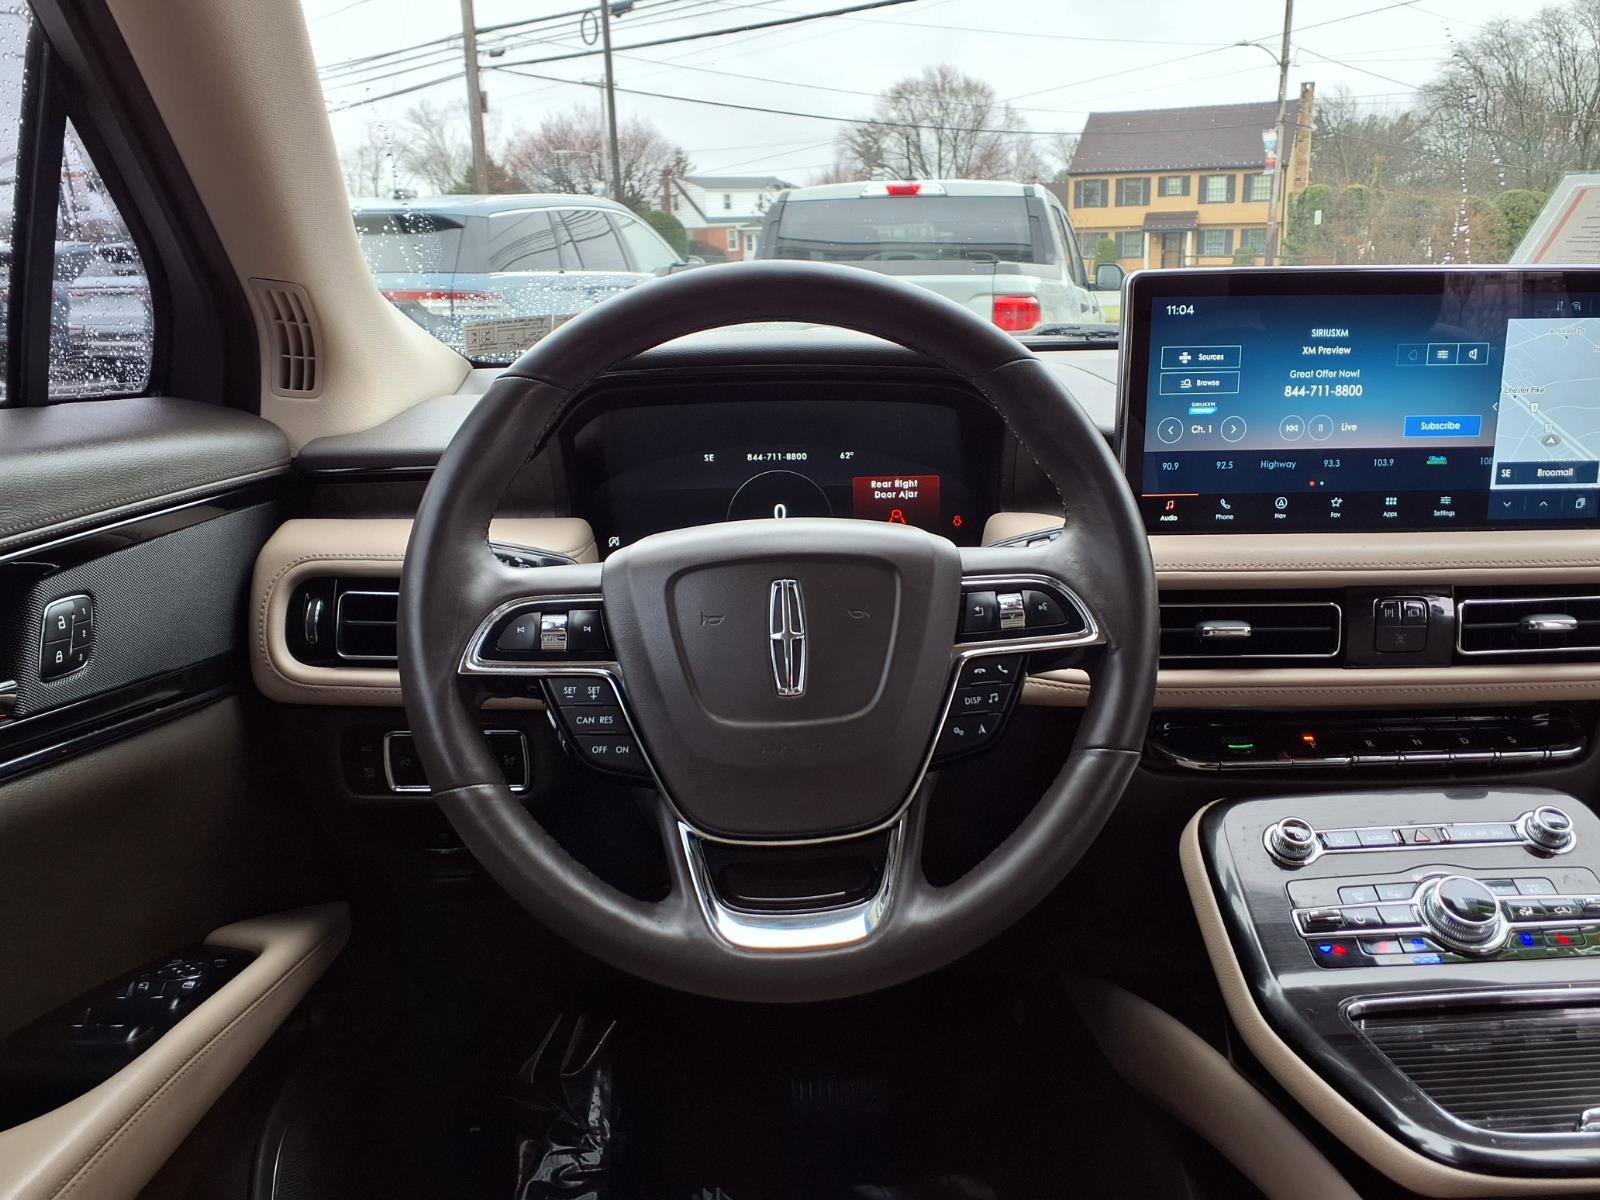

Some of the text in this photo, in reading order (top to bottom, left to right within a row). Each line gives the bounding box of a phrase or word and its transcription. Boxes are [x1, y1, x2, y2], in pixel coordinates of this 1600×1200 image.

[1166, 304, 1195, 316] 11:04
[1311, 328, 1349, 338] SIRIUSXM
[1302, 345, 1351, 355] XM Preview
[1198, 353, 1224, 361] Sources
[1289, 368, 1360, 379] Great Offer Now!
[1196, 378, 1220, 387] Browse
[1284, 384, 1363, 397] 844-711-8800
[1191, 424, 1212, 434] Ch. 1
[1341, 422, 1357, 432] Live
[1420, 421, 1461, 431] Subscribe
[704, 453, 715, 462] SE
[747, 452, 808, 462] 844-711-8800
[1162, 461, 1180, 472] 90.9
[1216, 460, 1234, 471] 92.5
[1260, 459, 1297, 470] Highway
[1323, 459, 1341, 469] 93.3
[1373, 458, 1395, 467] 103.9
[1501, 468, 1511, 478] SE
[1536, 467, 1574, 477] Broomall
[871, 478, 918, 490] Rear Right
[874, 489, 918, 500] Door Ajar
[773, 503, 787, 519] 0
[1383, 510, 1398, 518] Apps
[1433, 508, 1456, 518] Settings
[1160, 514, 1178, 522] Audio
[1215, 513, 1234, 521] Phone
[563, 686, 577, 694] SET
[587, 686, 601, 694] SET
[964, 696, 982, 705] DISP
[576, 715, 613, 725] CAN RES
[592, 745, 629, 754] OFF ON
